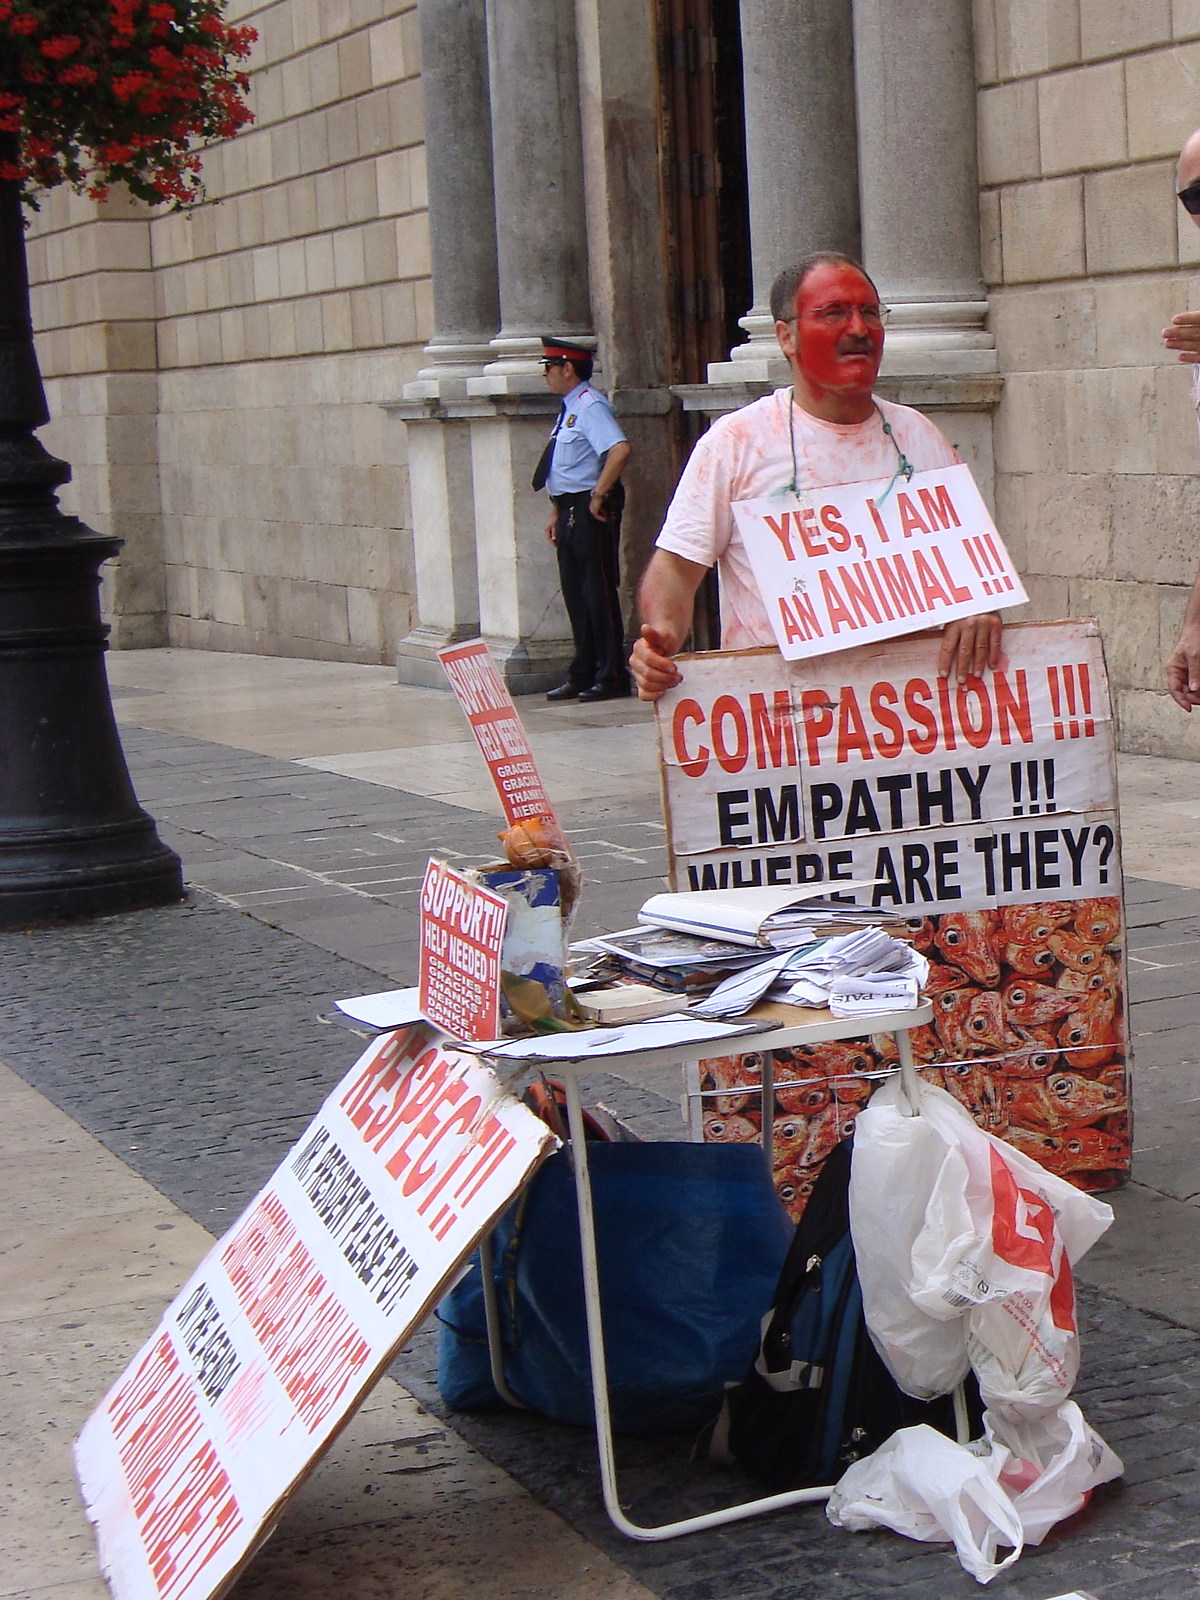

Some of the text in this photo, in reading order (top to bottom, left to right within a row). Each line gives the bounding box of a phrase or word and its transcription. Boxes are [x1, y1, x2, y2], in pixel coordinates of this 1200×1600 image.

[763, 485, 962, 561] YES, I AM
[778, 533, 1014, 645] AN ANIMAL !!!
[672, 663, 1096, 778] COMPASSION !!!
[717, 758, 1056, 847] EMPATHY !!!
[872, 840, 962, 907] ARE
[974, 825, 1114, 895] THEY?
[424, 870, 503, 952] SUPPORT!!
[425, 919, 447, 957] HELP
[449, 934, 487, 982] NEEDED
[429, 966, 482, 1005] GRACIAS
[427, 996, 470, 1029] DANKE
[427, 1007, 473, 1041] GRAZIE
[428, 975, 479, 1014] THANKS
[428, 986, 466, 1016] MERCI
[302, 1143, 371, 1239] PRESIDENT
[339, 1201, 400, 1286] PLEASE
[176, 1282, 209, 1331] ON
[183, 1297, 220, 1355] THE
[192, 1323, 241, 1407] AGENDA
[107, 1331, 243, 1600] STOP ANIMAL CRUELTY
